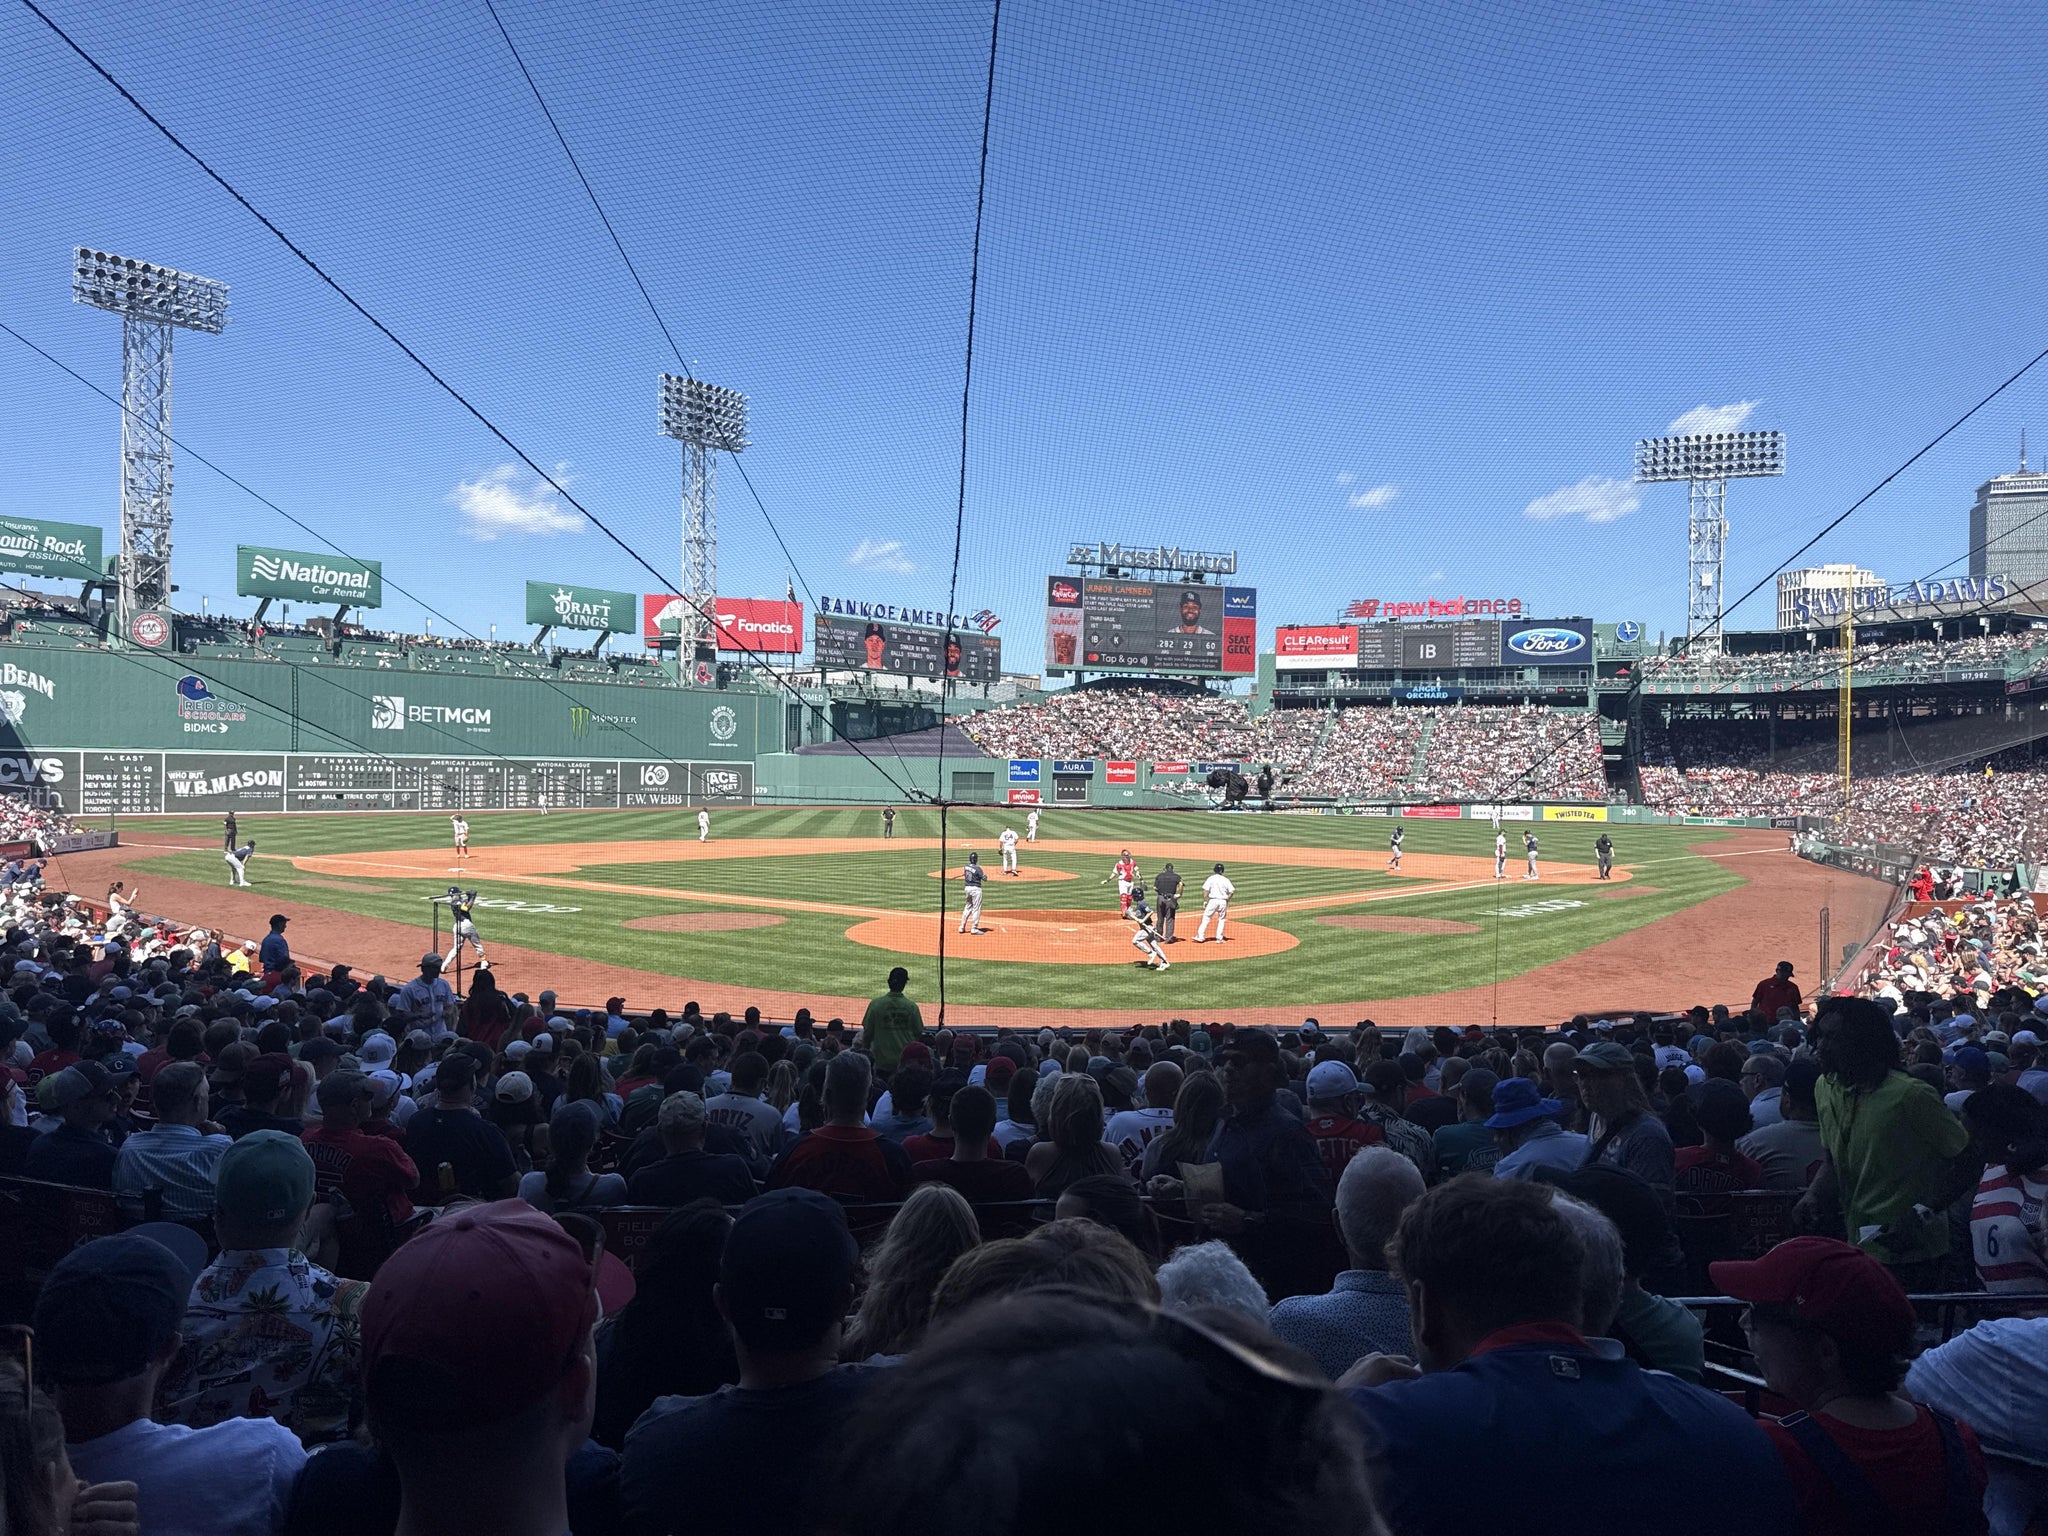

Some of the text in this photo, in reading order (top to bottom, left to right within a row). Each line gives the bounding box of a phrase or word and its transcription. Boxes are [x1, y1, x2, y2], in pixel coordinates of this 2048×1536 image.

[0, 534, 87, 556] outh Rock
[1099, 541, 1237, 574] MassMutual
[311, 585, 366, 599] Car Rental
[1086, 585, 1113, 594] JUNIOR
[1795, 573, 2008, 622] SAMUEL ADAMS
[555, 600, 611, 617] DRAFT
[1383, 595, 1522, 617] new balance
[821, 595, 970, 630] BANK OF AMERICA
[561, 612, 609, 628] KINGS
[738, 619, 793, 634] Fanatics
[1113, 636, 1119, 644] K
[1183, 641, 1193, 649] 29
[1205, 642, 1216, 650] 60
[1228, 634, 1251, 645] SEAT
[1284, 635, 1350, 646] CLEAResult
[1523, 633, 1568, 650] Ford
[1226, 645, 1251, 655] GEEK
[894, 658, 934, 672] 0 1 0
[1101, 653, 1138, 665] Tap & go
[3, 663, 57, 700] BEAM
[1961, 672, 1989, 680] $17,982
[1412, 685, 1441, 693] ANGRY
[1648, 685, 1656, 694] 9
[1664, 685, 1672, 694] 4
[1772, 683, 1784, 692] 45
[1406, 691, 1448, 699] ORCHARD
[184, 701, 247, 713] RED SOX
[184, 710, 246, 721] SCHOLARS
[408, 704, 491, 725] BETMGM
[591, 713, 638, 725] MONSTER
[183, 722, 218, 733] BIDMC
[0, 757, 65, 783] CVS
[167, 771, 205, 780] WHO BUT
[640, 765, 669, 786] 160
[1107, 767, 1135, 775] Satellite
[210, 769, 284, 794] MASON
[708, 772, 738, 784] ACE
[710, 783, 738, 795] TICKET
[626, 793, 683, 805] F.W. WEBB
[1012, 793, 1036, 801] IRVING
[1555, 811, 1595, 820] TWISTED TEA
[1622, 808, 1637, 816] 380
[535, 1039, 543, 1049] B
[114, 1060, 124, 1070] G
[709, 1108, 754, 1131] ORTIZ
[1315, 1137, 1360, 1159] ETTS
[1987, 1224, 1999, 1258] 6
